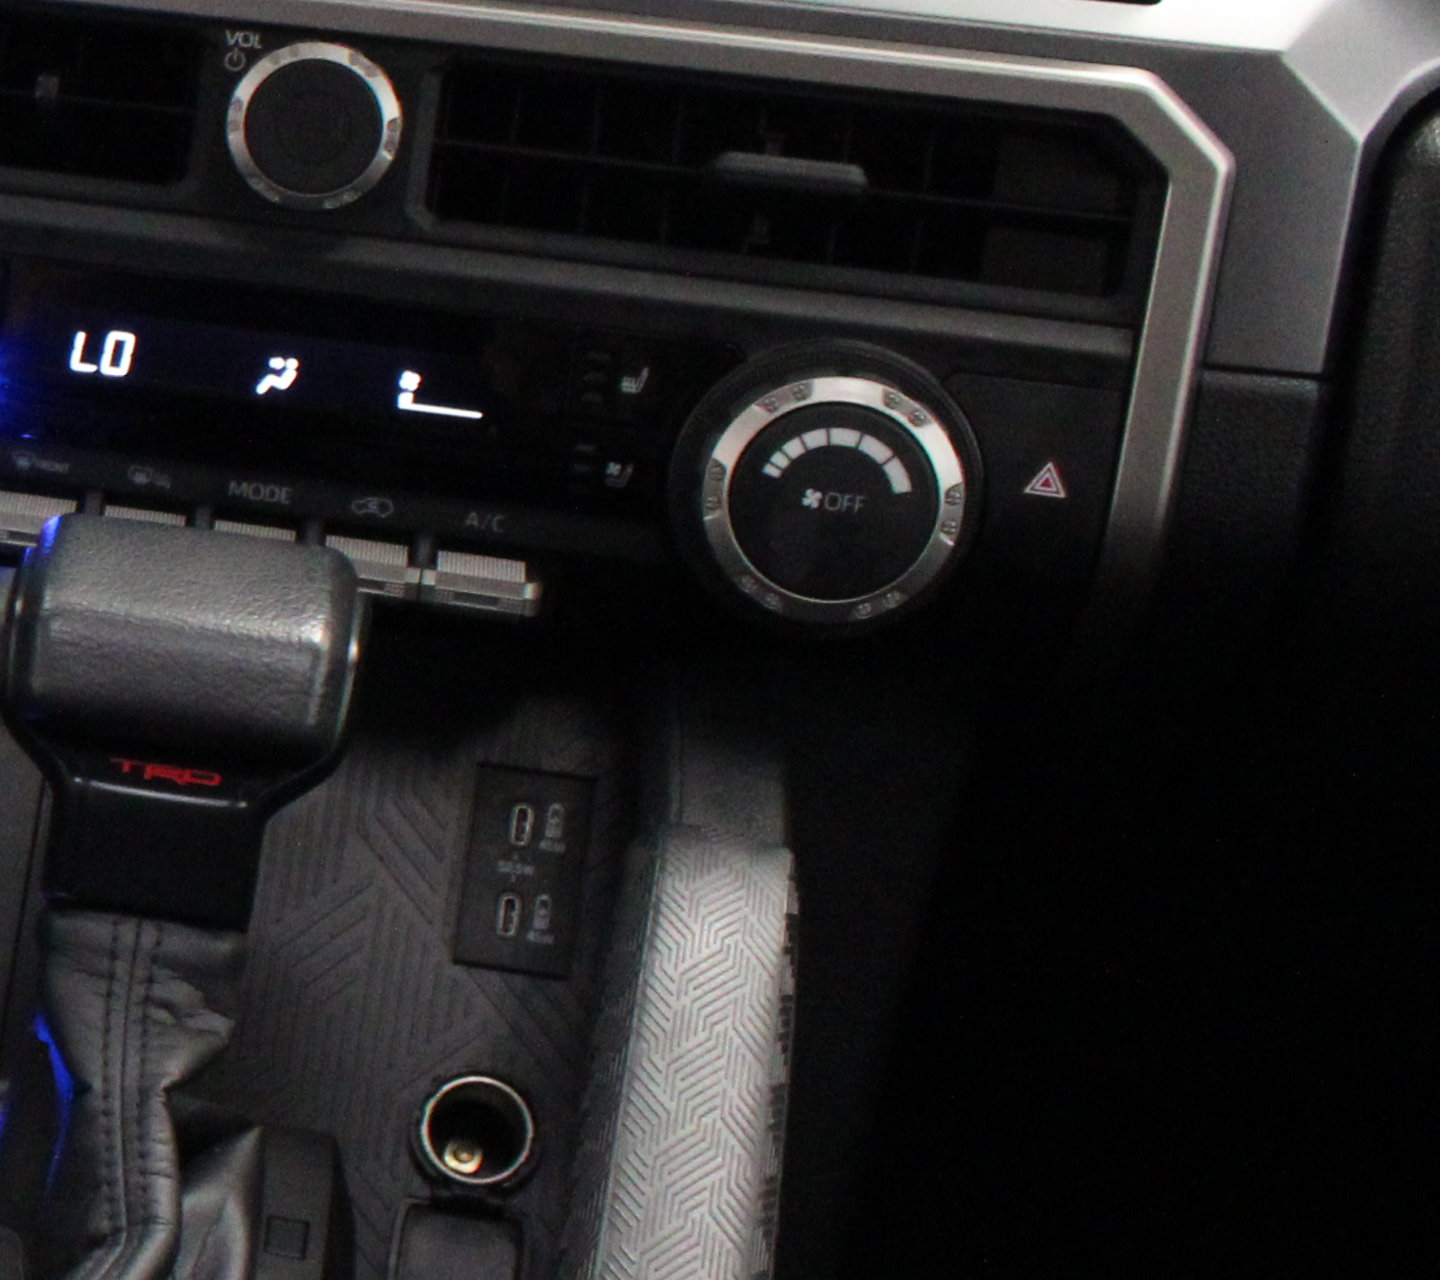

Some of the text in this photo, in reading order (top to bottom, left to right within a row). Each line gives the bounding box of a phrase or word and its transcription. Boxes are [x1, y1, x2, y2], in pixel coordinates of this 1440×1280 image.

[225, 30, 262, 49] VOL
[69, 331, 137, 378] LO
[228, 480, 292, 506] MODE
[823, 492, 866, 514] OFF
[465, 511, 505, 533] A/C
[110, 757, 222, 787] TRD
